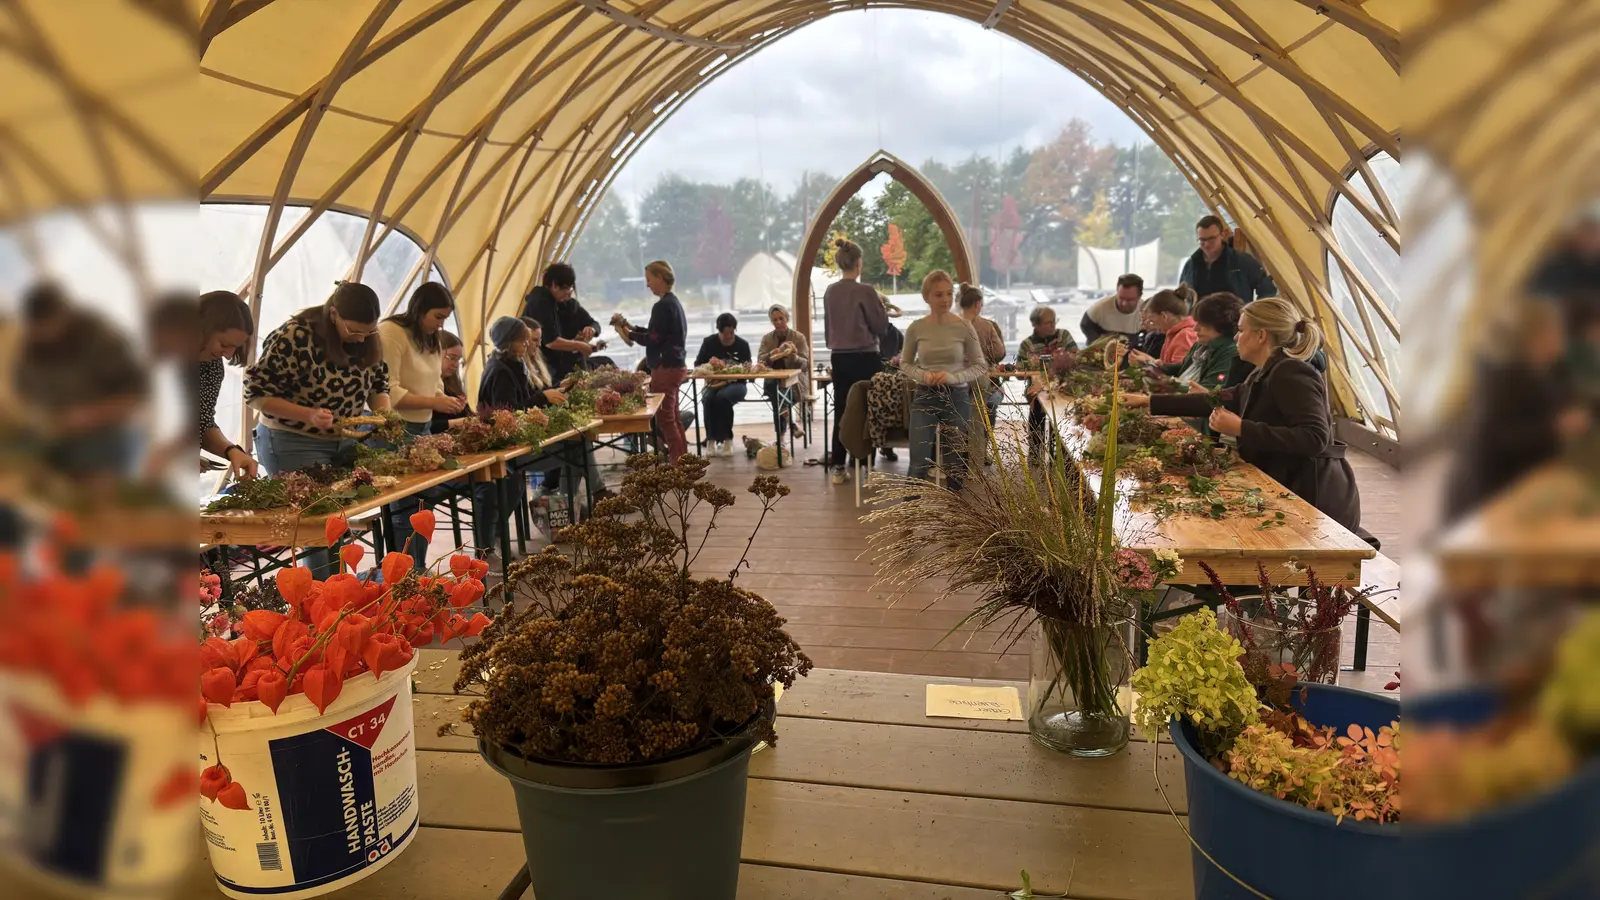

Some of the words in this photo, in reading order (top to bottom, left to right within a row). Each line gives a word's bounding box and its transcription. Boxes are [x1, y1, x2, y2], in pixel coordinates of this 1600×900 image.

[348, 723, 364, 738] CT
[370, 712, 386, 730] 34
[337, 747, 361, 854] HANDWASCH-
[361, 800, 377, 846] PASTE
